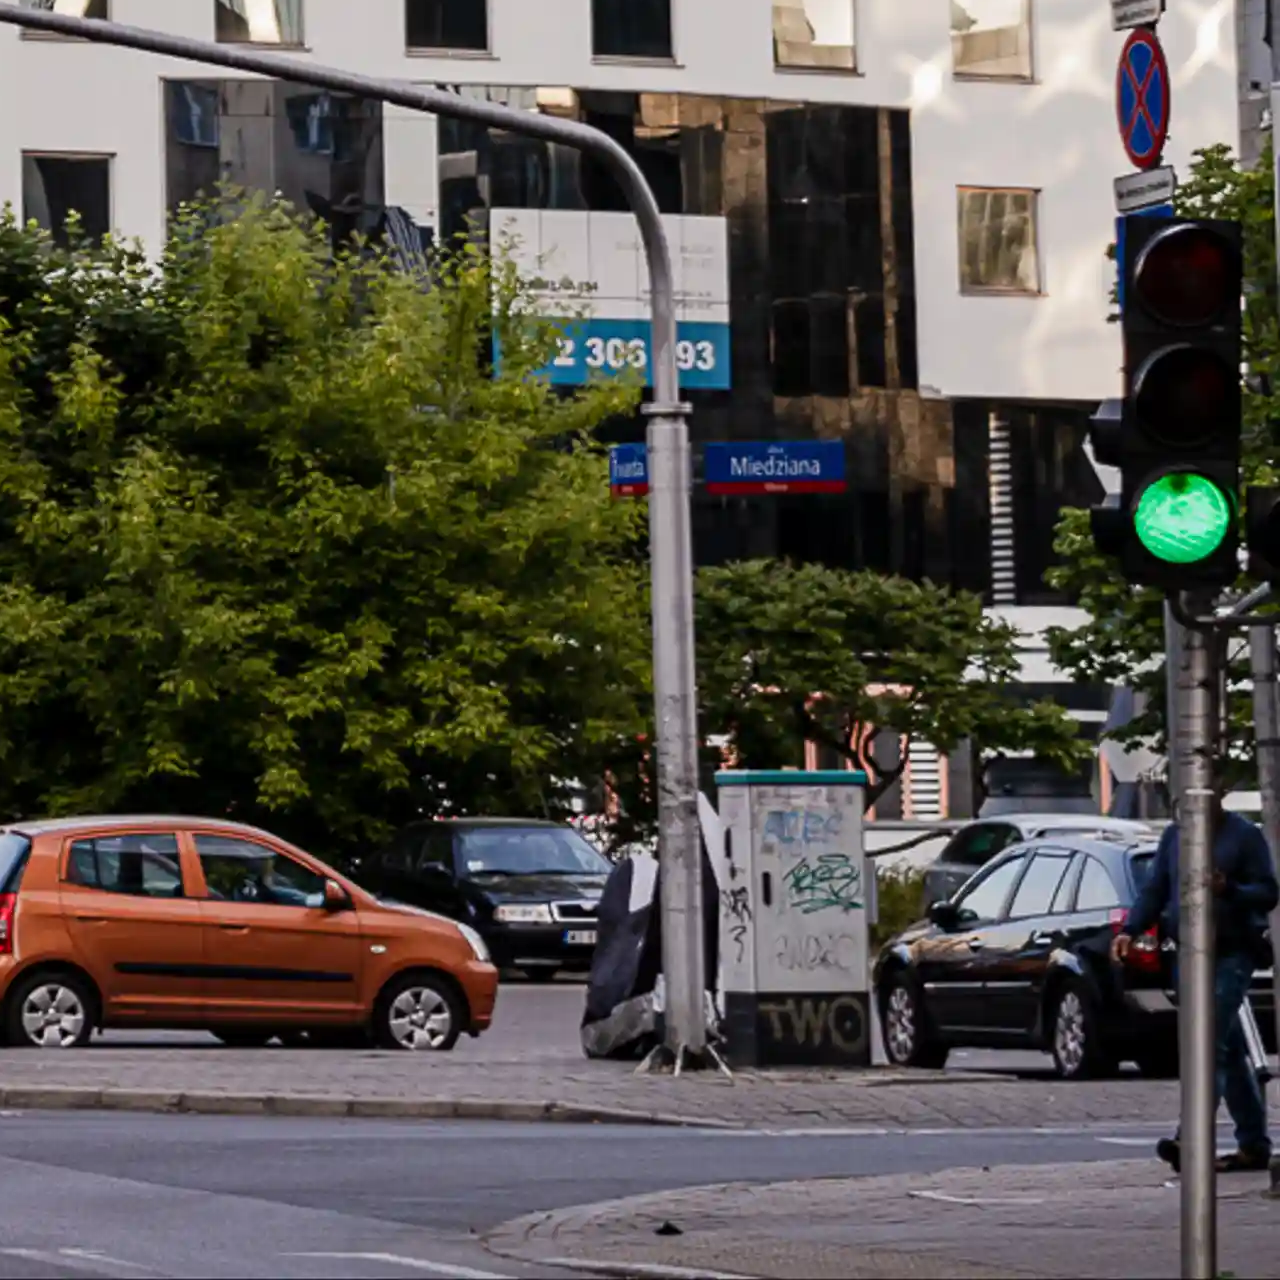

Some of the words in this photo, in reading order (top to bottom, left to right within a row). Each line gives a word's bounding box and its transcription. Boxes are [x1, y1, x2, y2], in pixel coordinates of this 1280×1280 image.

[585, 337, 648, 369] 306
[675, 340, 716, 371] 93
[730, 454, 821, 477] Miedziana
[758, 995, 865, 1053] TWO
